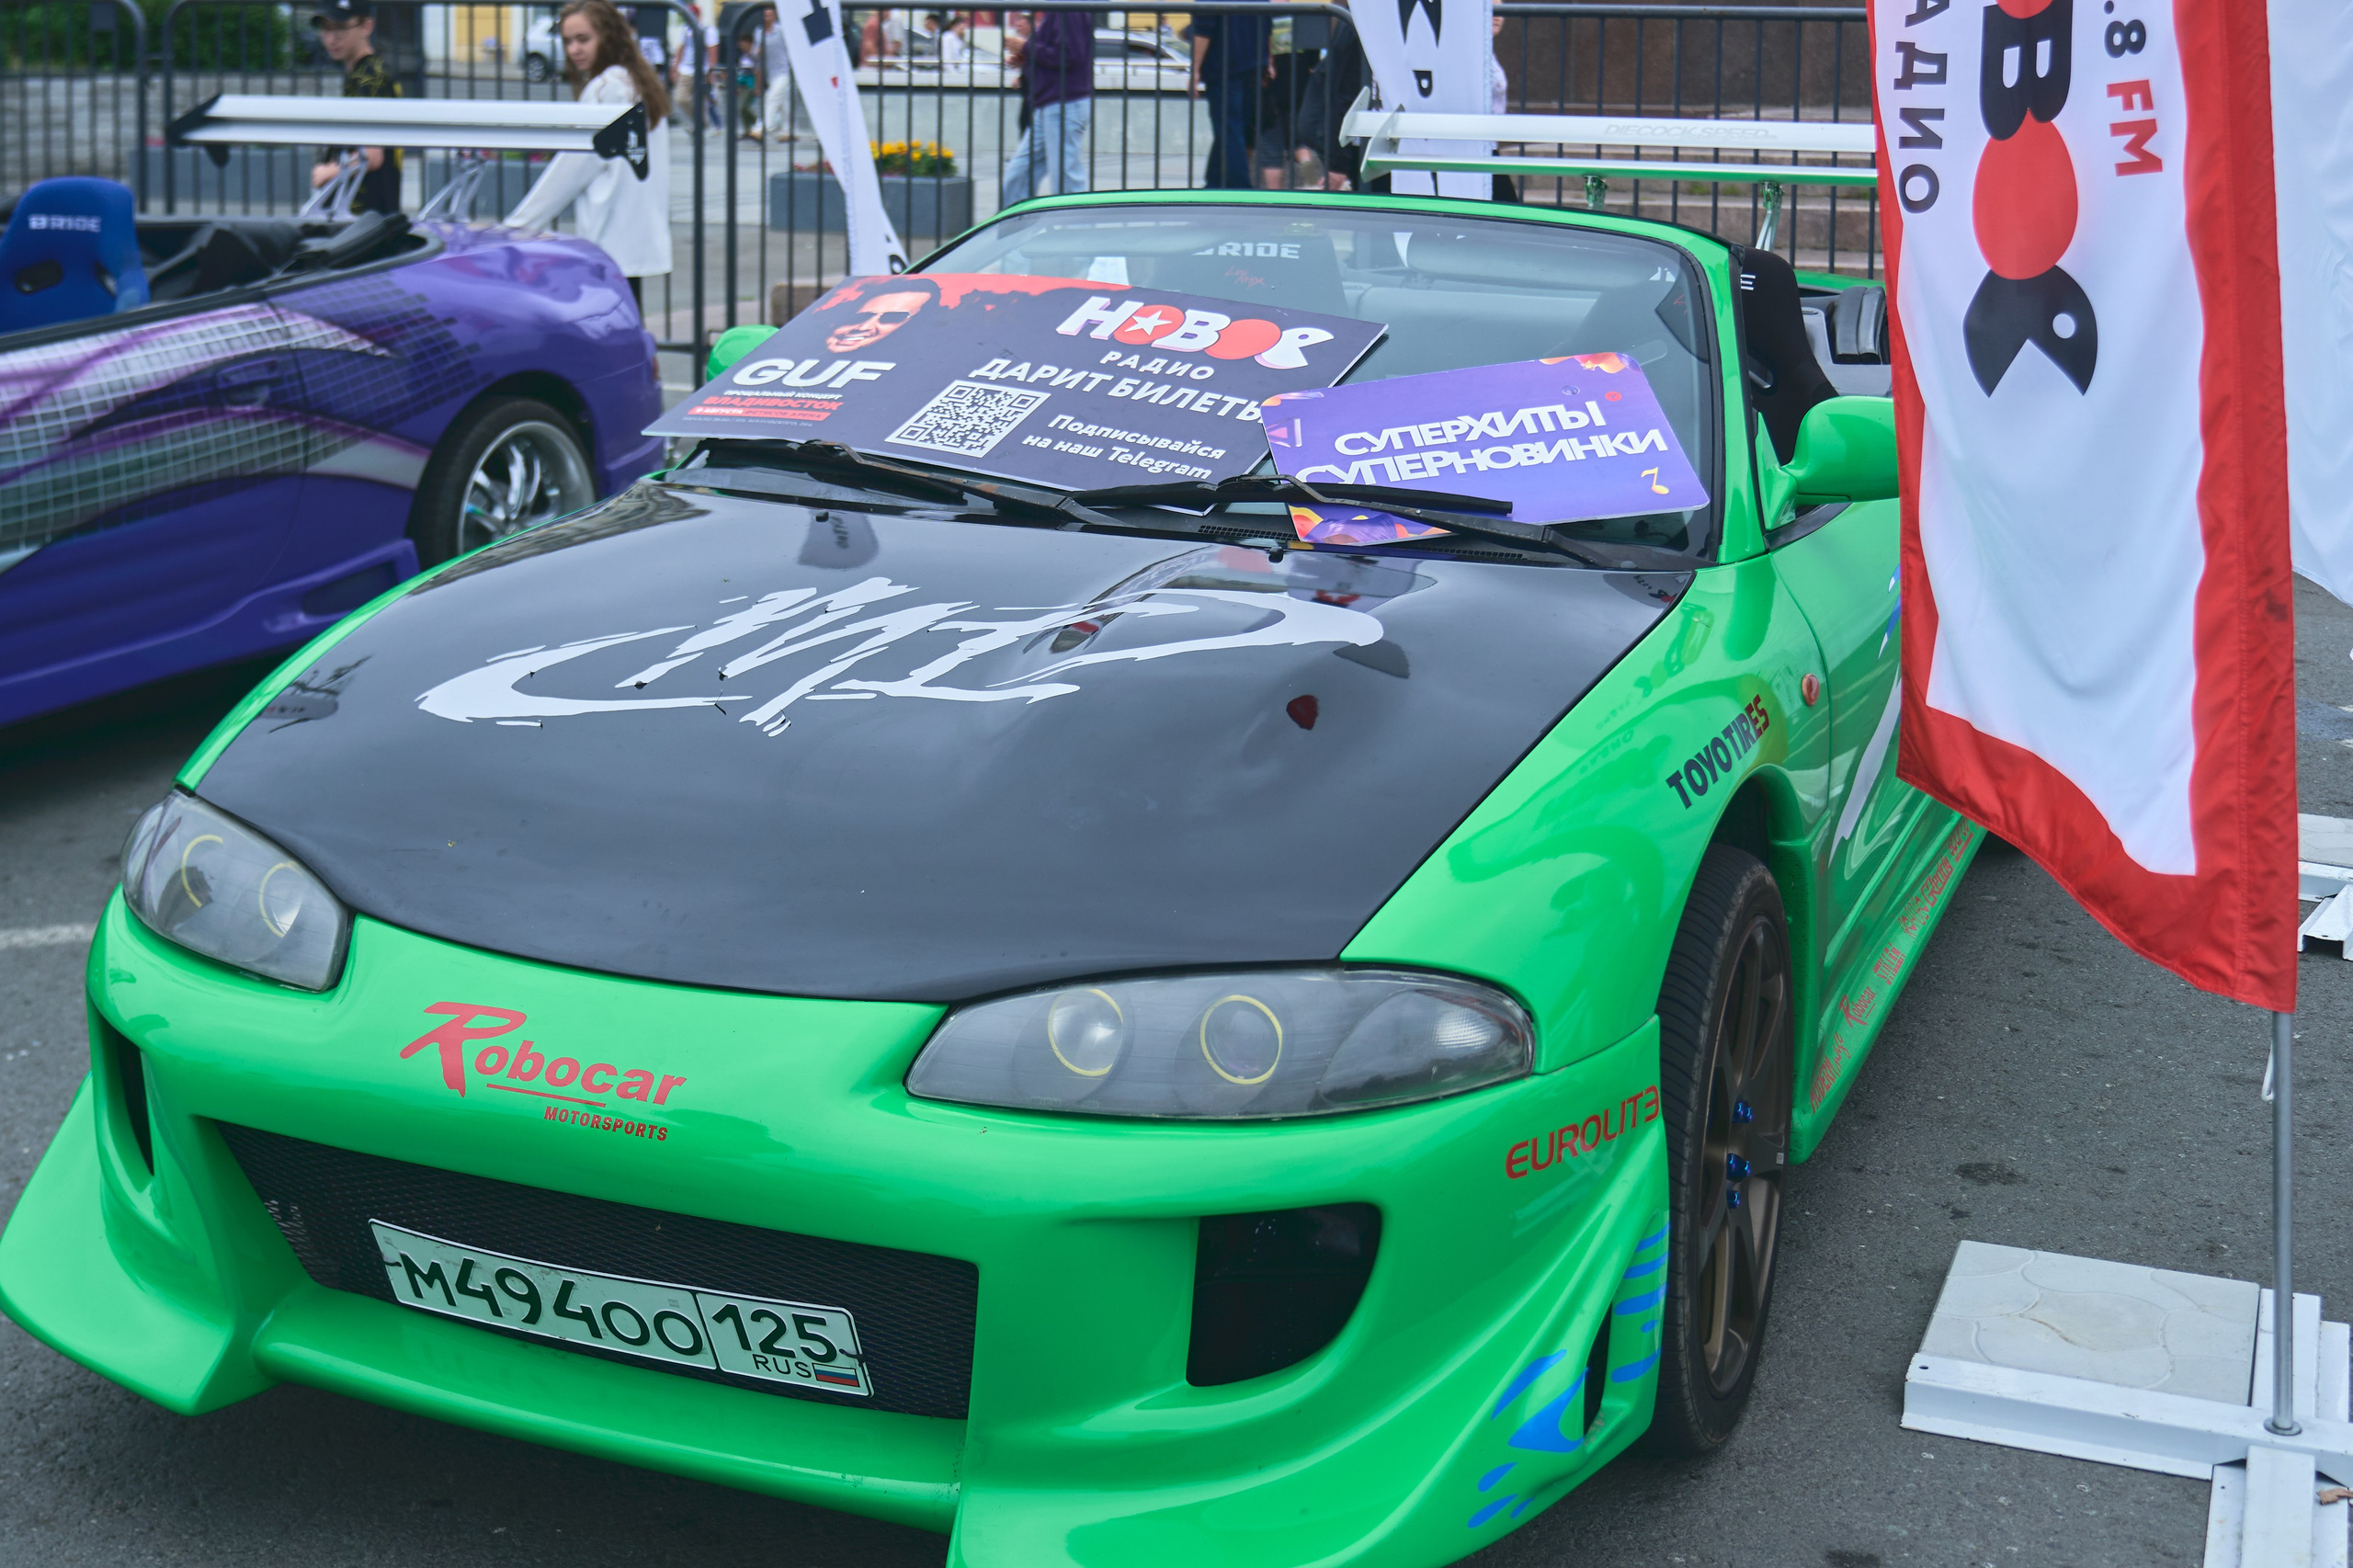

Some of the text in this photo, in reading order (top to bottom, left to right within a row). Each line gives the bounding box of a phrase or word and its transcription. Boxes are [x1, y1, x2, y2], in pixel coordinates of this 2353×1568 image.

[2106, 79, 2164, 177] FM
[733, 358, 897, 388] GUF
[968, 358, 1115, 392] ДАРИТ
[1100, 351, 1215, 381] РАДИО
[702, 395, 845, 411] ВЛАДИВОСТОК
[723, 389, 844, 402] ПРОЩАЛЬНЫЙ КОНЦЕРТ
[1048, 414, 1227, 460] Подписывайся
[1335, 401, 1607, 456] СУПЕРХИТЫ
[1022, 435, 1212, 480] на наш Telegram
[1294, 428, 1668, 485] СУПЕРНОВИНКИ
[1665, 694, 1769, 810] TOYO TIRES
[1839, 986, 1876, 1028] Robocar
[400, 1001, 688, 1106] Robocar
[1809, 1055, 1836, 1114] MODERN
[543, 1106, 668, 1142] MOTORSPORTS
[711, 1303, 838, 1363] 125
[752, 1353, 813, 1380] RUS
